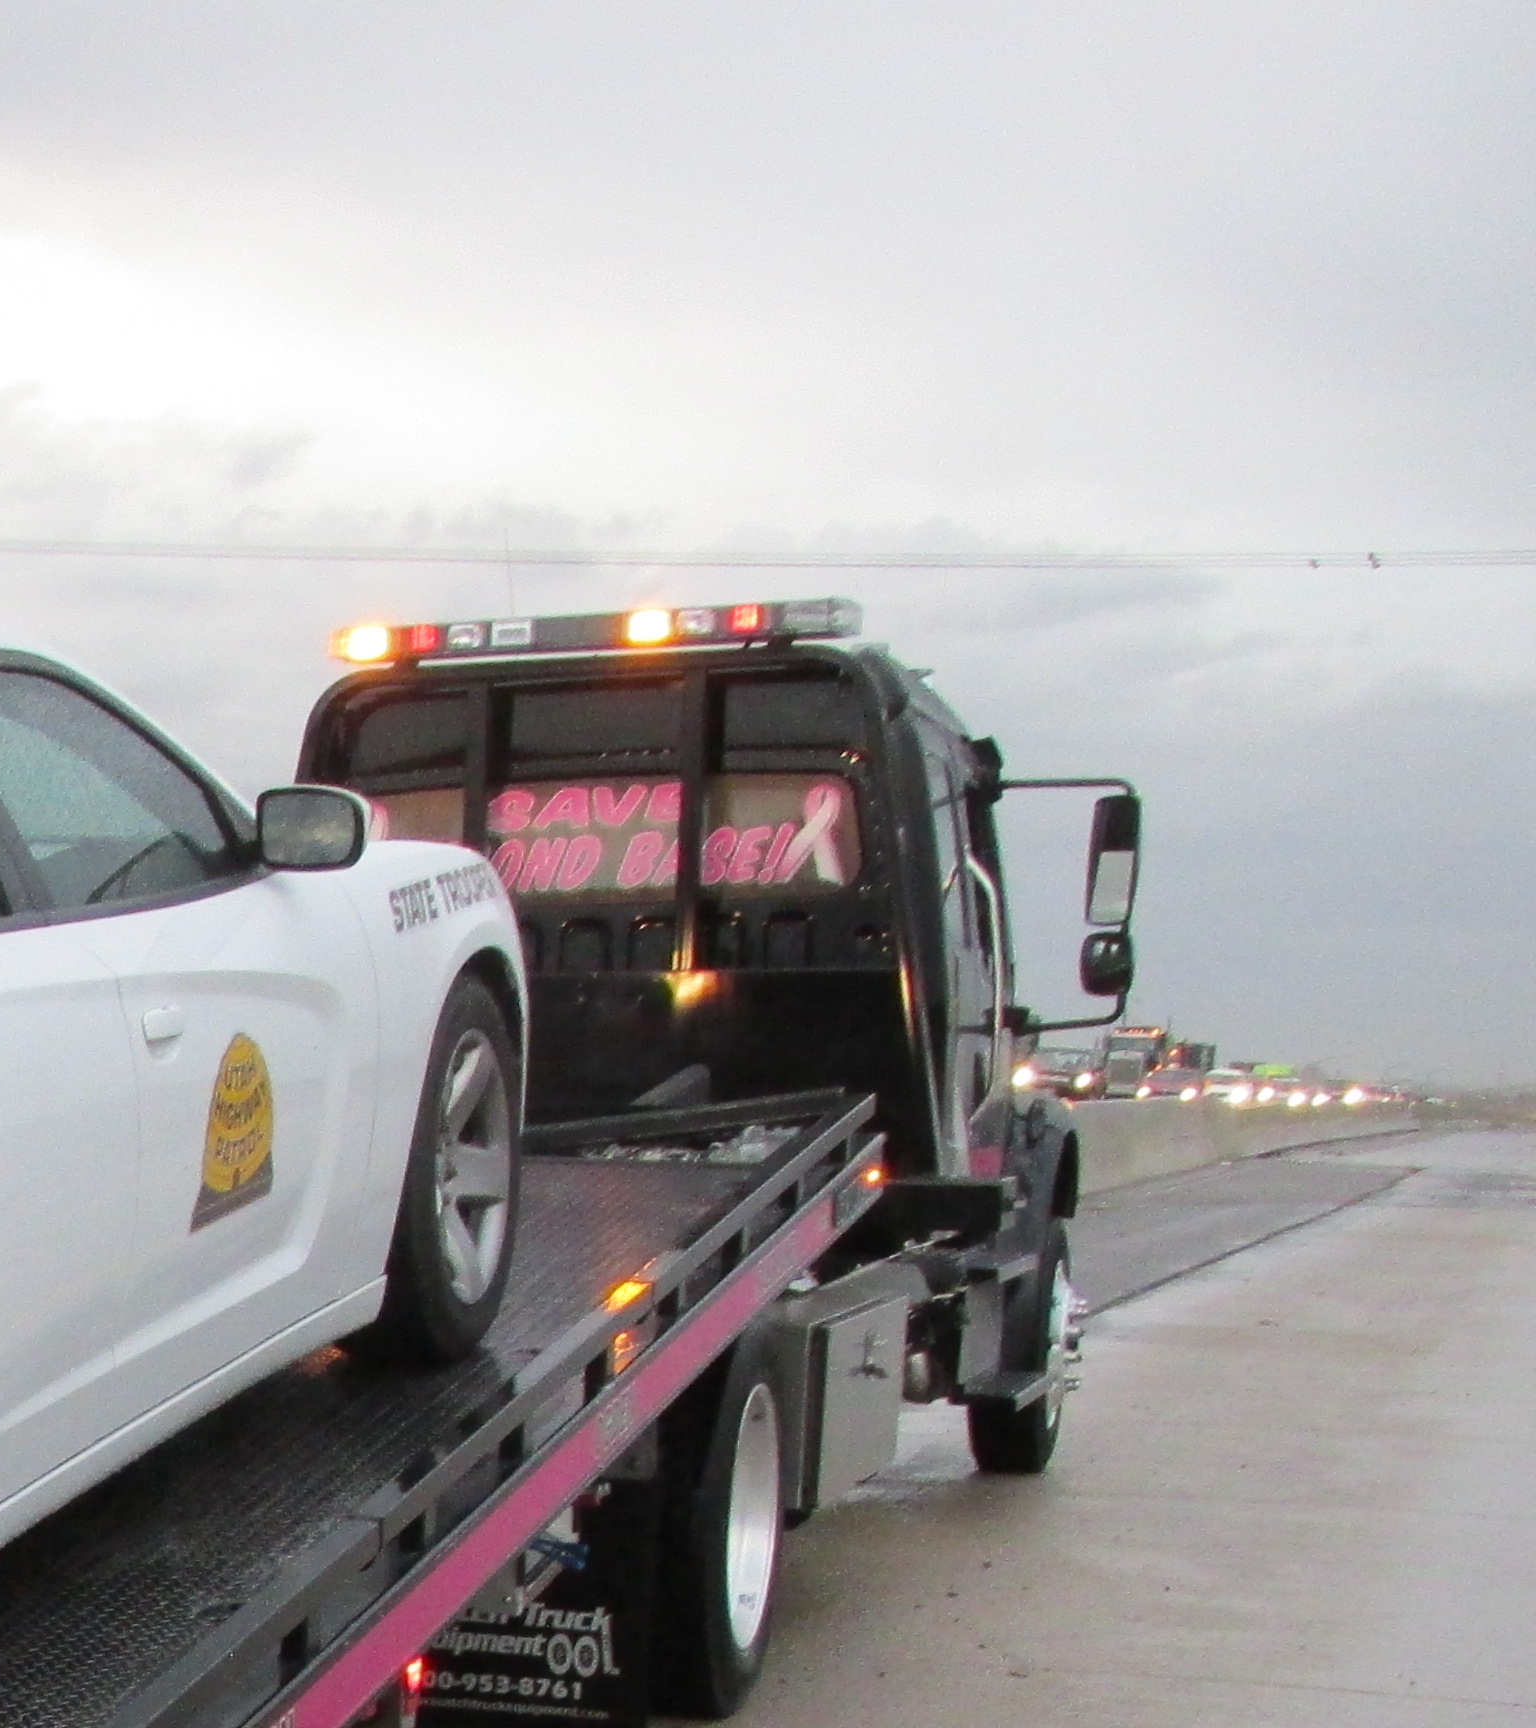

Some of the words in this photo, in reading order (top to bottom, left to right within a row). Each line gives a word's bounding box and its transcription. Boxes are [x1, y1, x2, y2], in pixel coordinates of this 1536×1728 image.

[487, 780, 682, 834] SAVE
[389, 878, 438, 933] STATE
[523, 1601, 612, 1637] Truck
[422, 1670, 583, 1701] 00-953-8761
